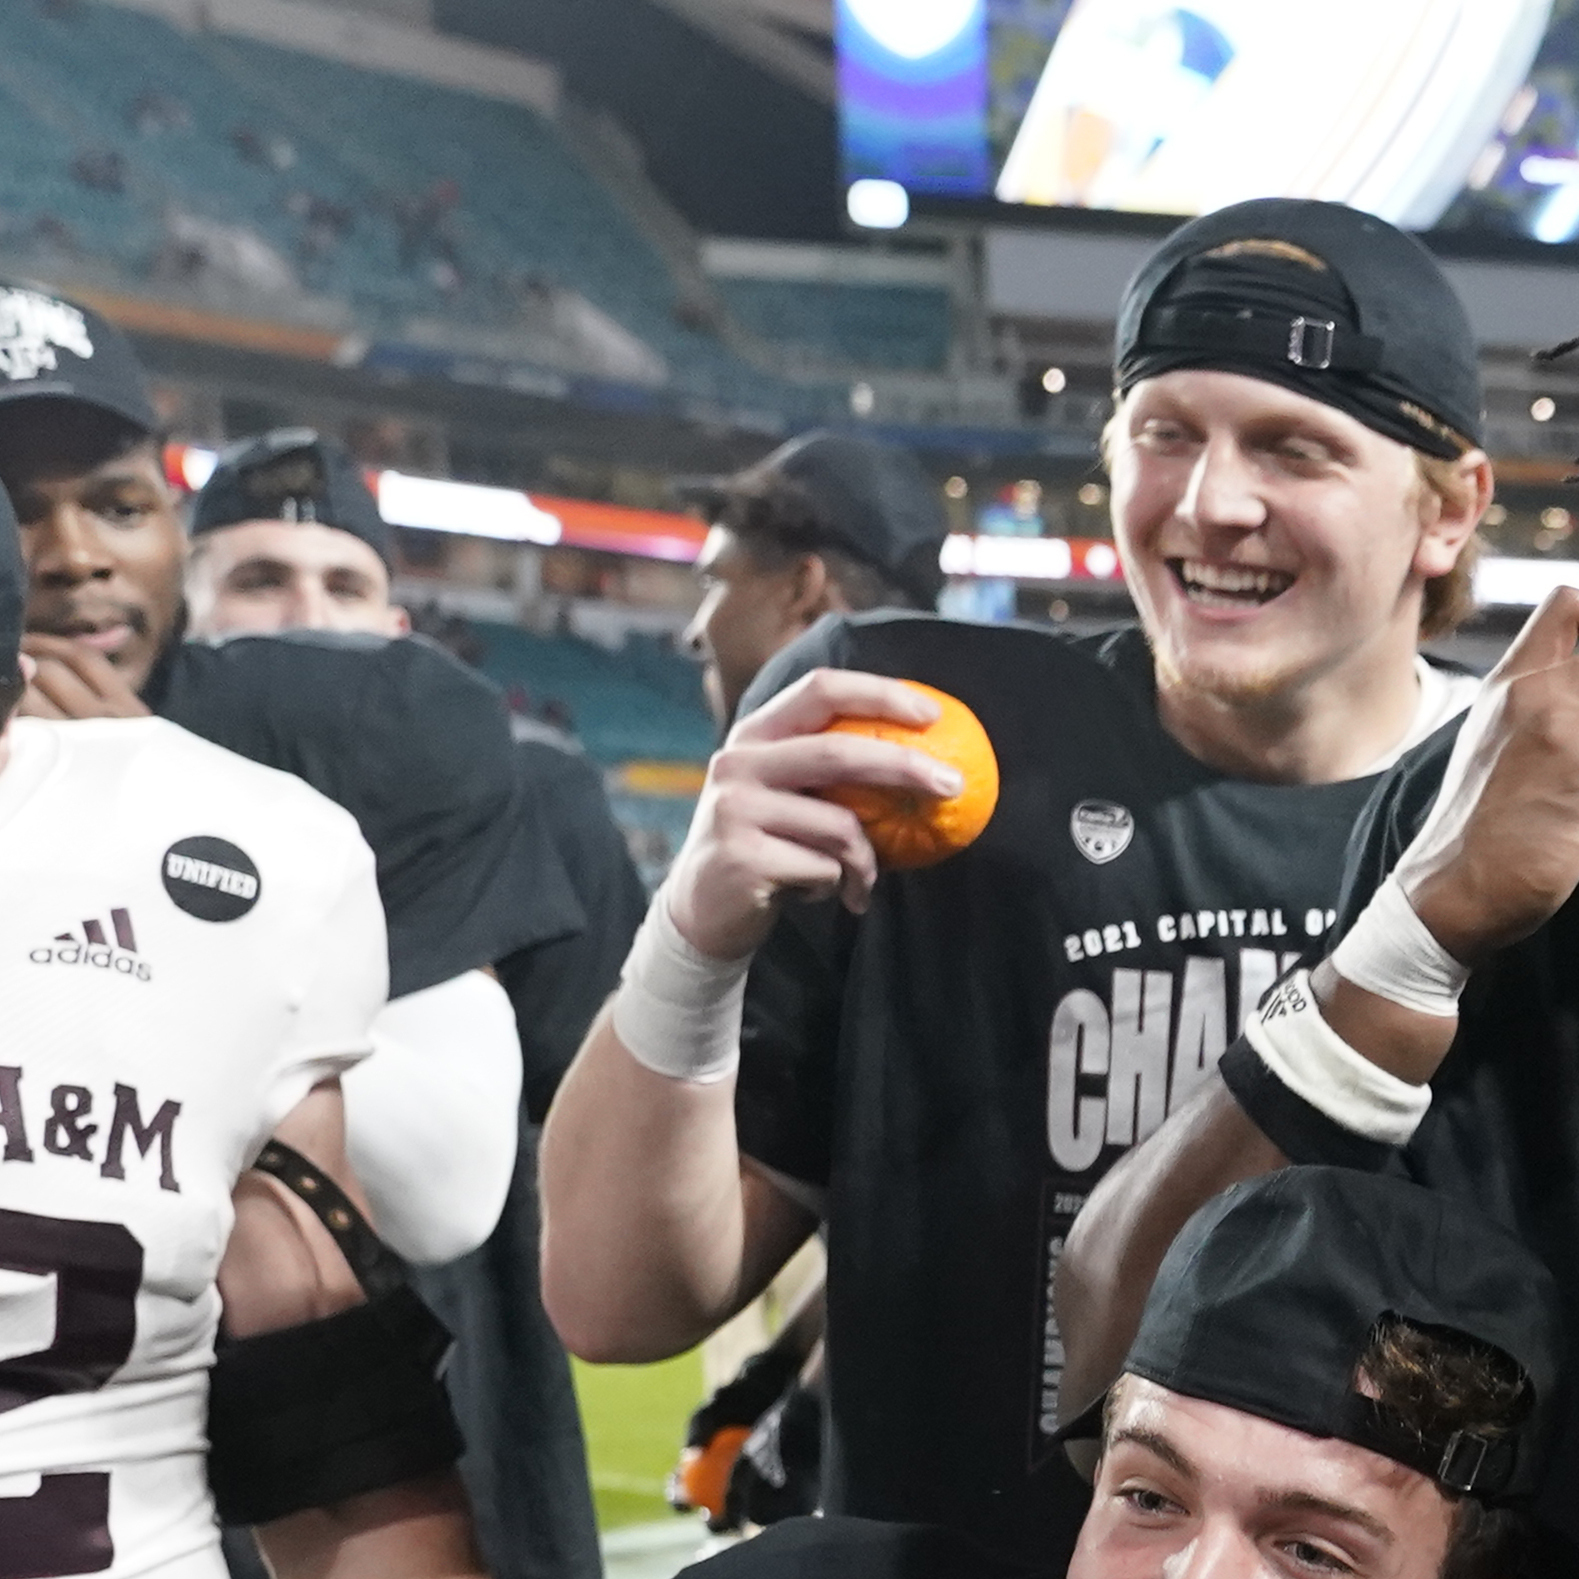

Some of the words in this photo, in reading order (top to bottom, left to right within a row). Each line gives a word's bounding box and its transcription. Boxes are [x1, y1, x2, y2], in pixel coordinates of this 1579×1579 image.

[167, 853, 258, 901] UNIFIED
[1063, 920, 1141, 963] 2021
[1156, 907, 1288, 943] CAPITAL
[29, 942, 152, 983] adidas
